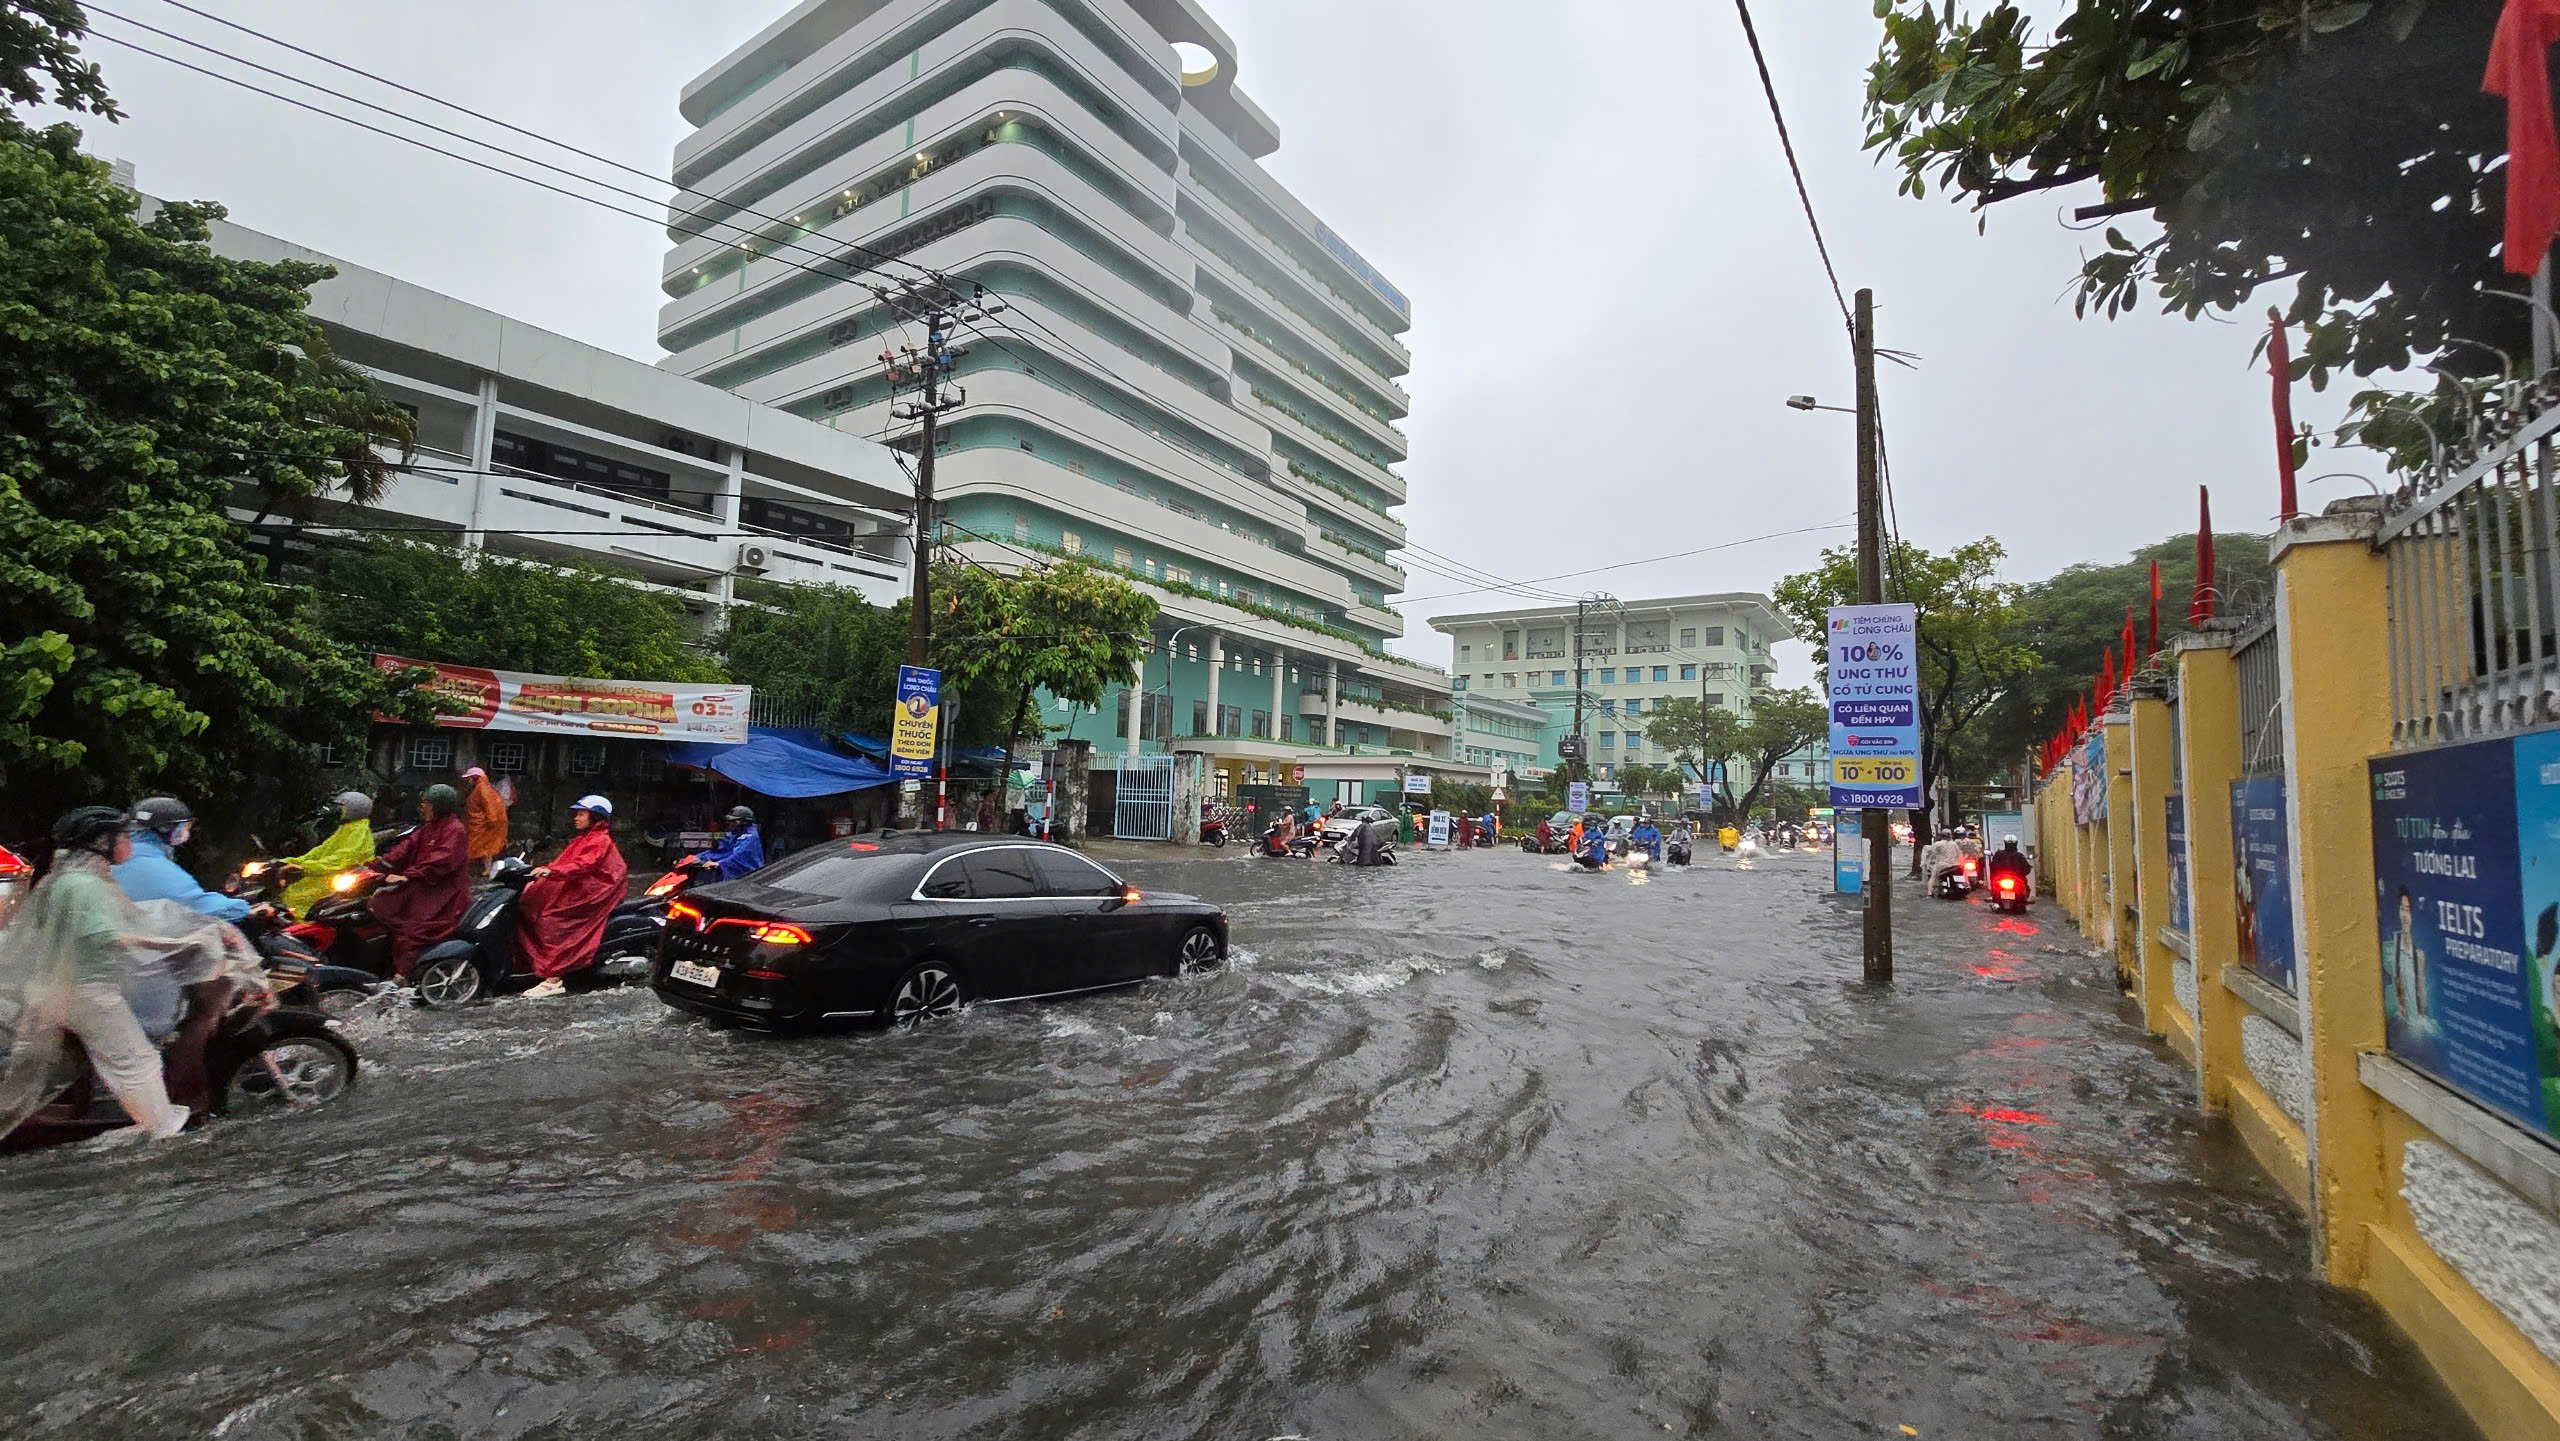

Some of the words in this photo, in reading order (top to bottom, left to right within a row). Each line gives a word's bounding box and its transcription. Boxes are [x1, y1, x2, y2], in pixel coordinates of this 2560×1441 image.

[1853, 616, 1871, 624] TIÊM
[1853, 626, 1881, 635] LONG
[1884, 623, 1911, 633] CHÂU
[1838, 668, 1870, 679] UNG
[1875, 665, 1909, 679] THƯ
[432, 678, 480, 692] BACK
[903, 683, 920, 691] LONG
[1833, 683, 1851, 695] CỔ
[1854, 683, 1872, 695] TỬ
[1875, 685, 1913, 694] CUNG
[509, 695, 582, 715] CHỌN
[586, 696, 678, 723] SOPHIA
[692, 702, 717, 716] 03
[1838, 704, 1852, 713] CÓ
[1855, 703, 1876, 713] LIÊN
[1879, 704, 1909, 714] QUAN
[899, 719, 933, 729] CHUYÊN
[1851, 714, 1872, 724] ĐẾN
[1875, 716, 1895, 724] HPV
[899, 729, 931, 740] THUỐC
[1850, 794, 1875, 804] 1800
[1877, 794, 1904, 804] 6928
[2410, 817, 2431, 839] TIN
[2413, 850, 2453, 877] TƯƠNG
[2453, 855, 2477, 879] LAI
[2437, 900, 2484, 939] IELTS
[2444, 937, 2519, 975] PREPARATORY
